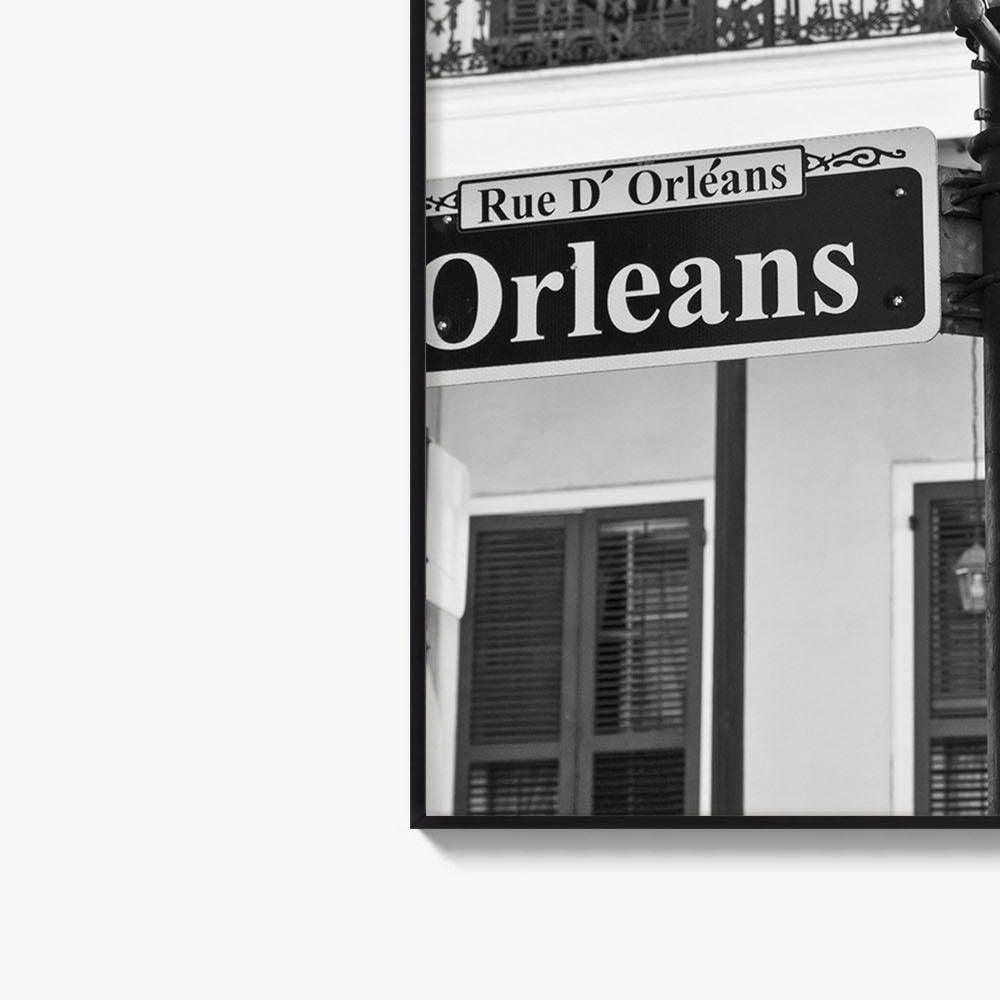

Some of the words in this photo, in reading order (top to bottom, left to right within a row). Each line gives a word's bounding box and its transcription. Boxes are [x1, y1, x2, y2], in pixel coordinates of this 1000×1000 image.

[478, 187, 556, 224] Rue
[628, 158, 787, 206] Orléans
[426, 240, 859, 352] Orleans
